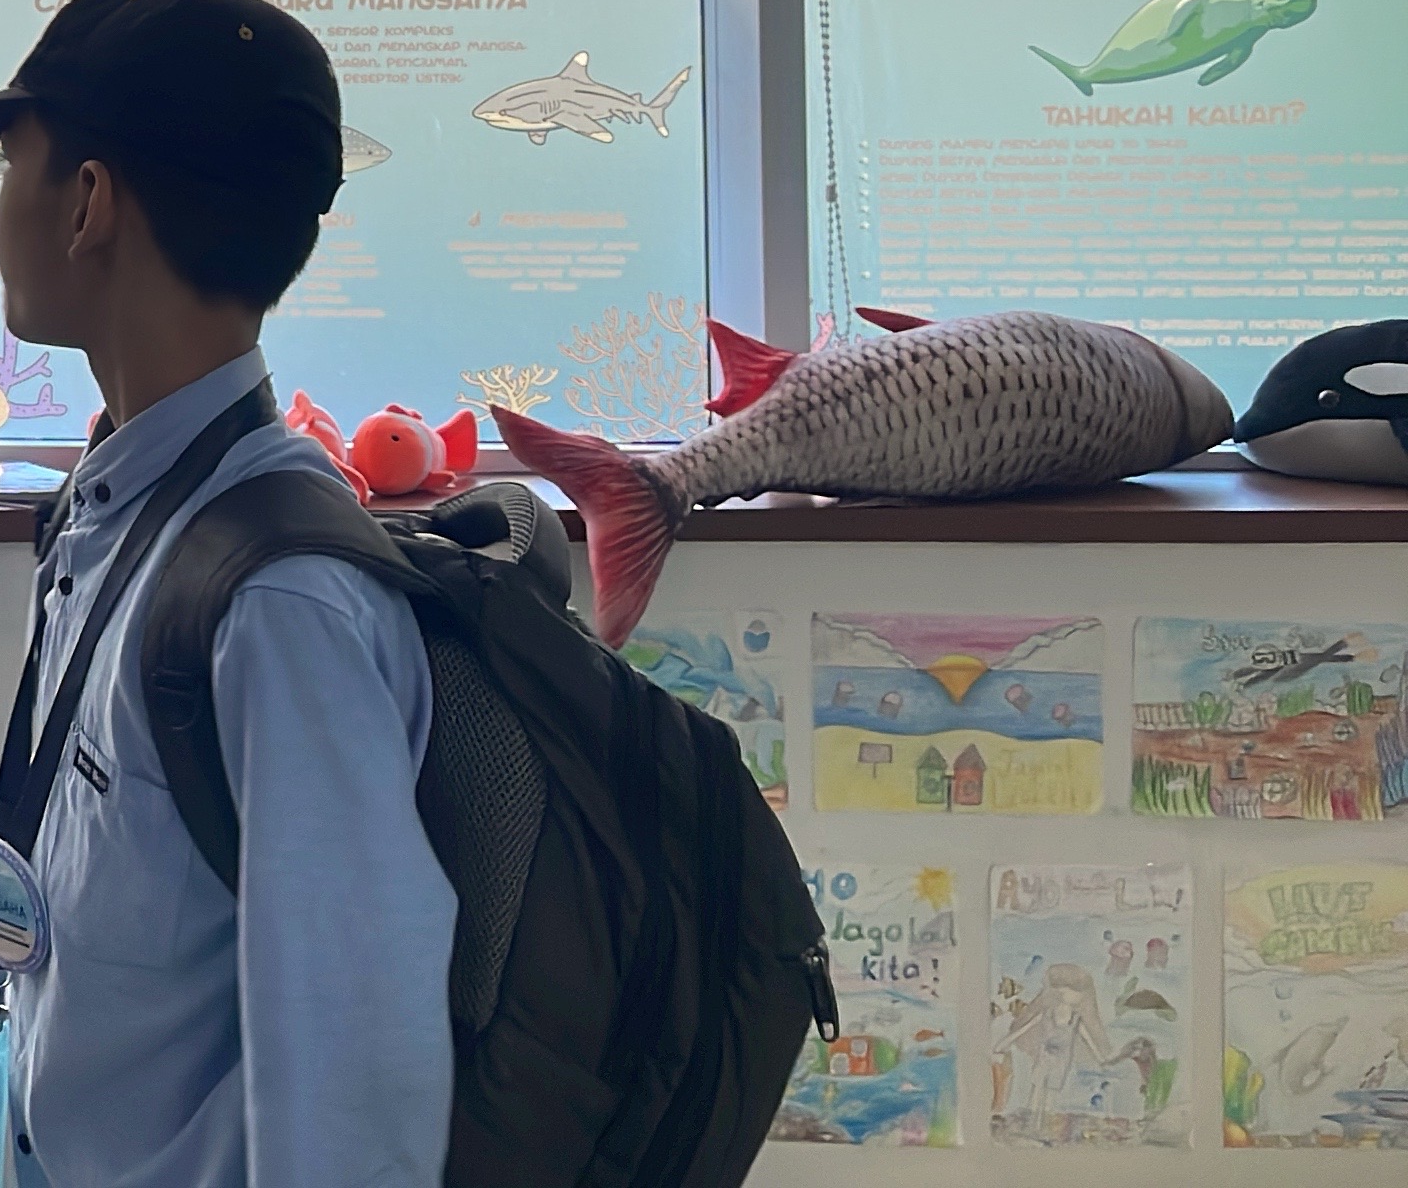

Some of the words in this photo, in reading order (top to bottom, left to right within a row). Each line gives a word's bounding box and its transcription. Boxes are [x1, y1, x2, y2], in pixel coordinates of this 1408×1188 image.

[327, 26, 380, 37] SENSOR
[384, 25, 454, 36] KOMPLEKS
[343, 43, 372, 53] DAN
[377, 42, 461, 53] MENANGKAP
